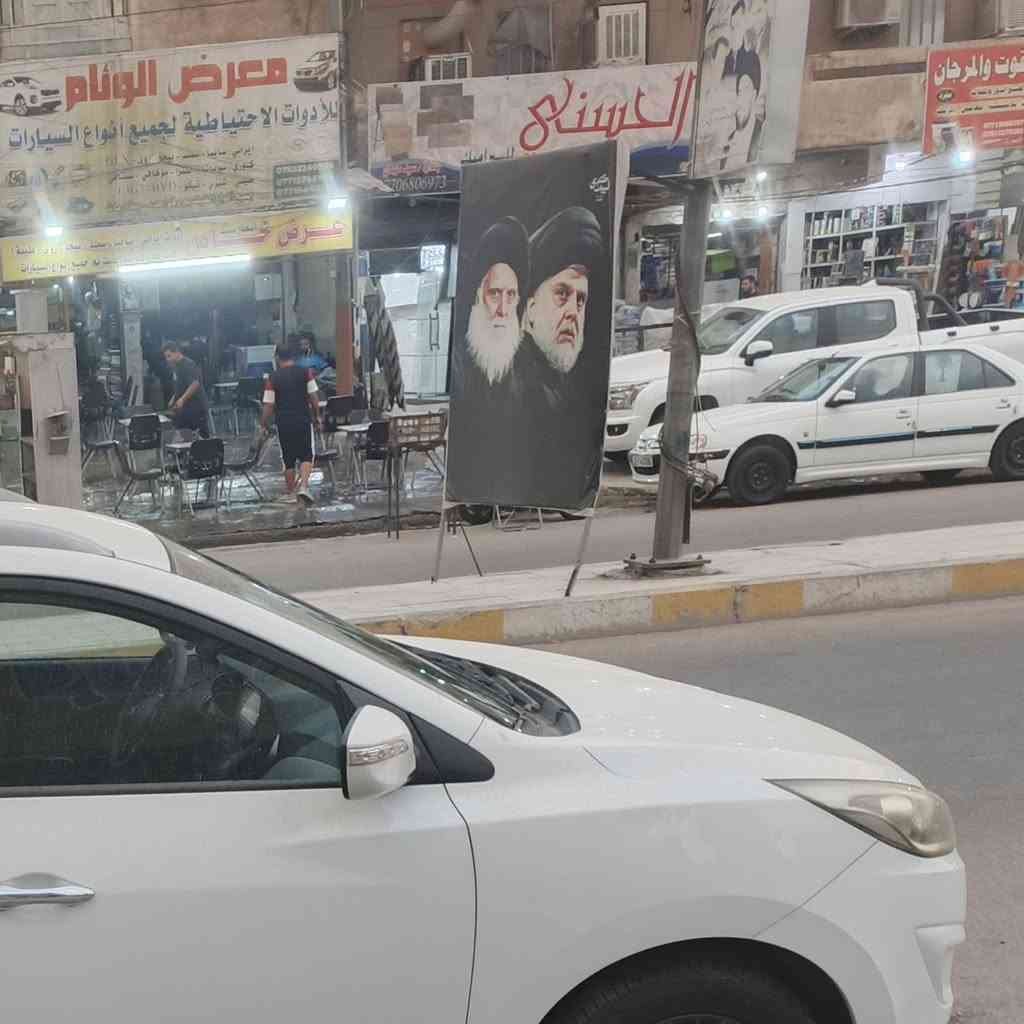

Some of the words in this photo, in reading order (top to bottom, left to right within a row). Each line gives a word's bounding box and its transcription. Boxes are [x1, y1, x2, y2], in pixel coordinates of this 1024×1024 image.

[167, 53, 288, 104] معرض
[8, 124, 80, 152] السيارات
[128, 114, 177, 145] لجميع
